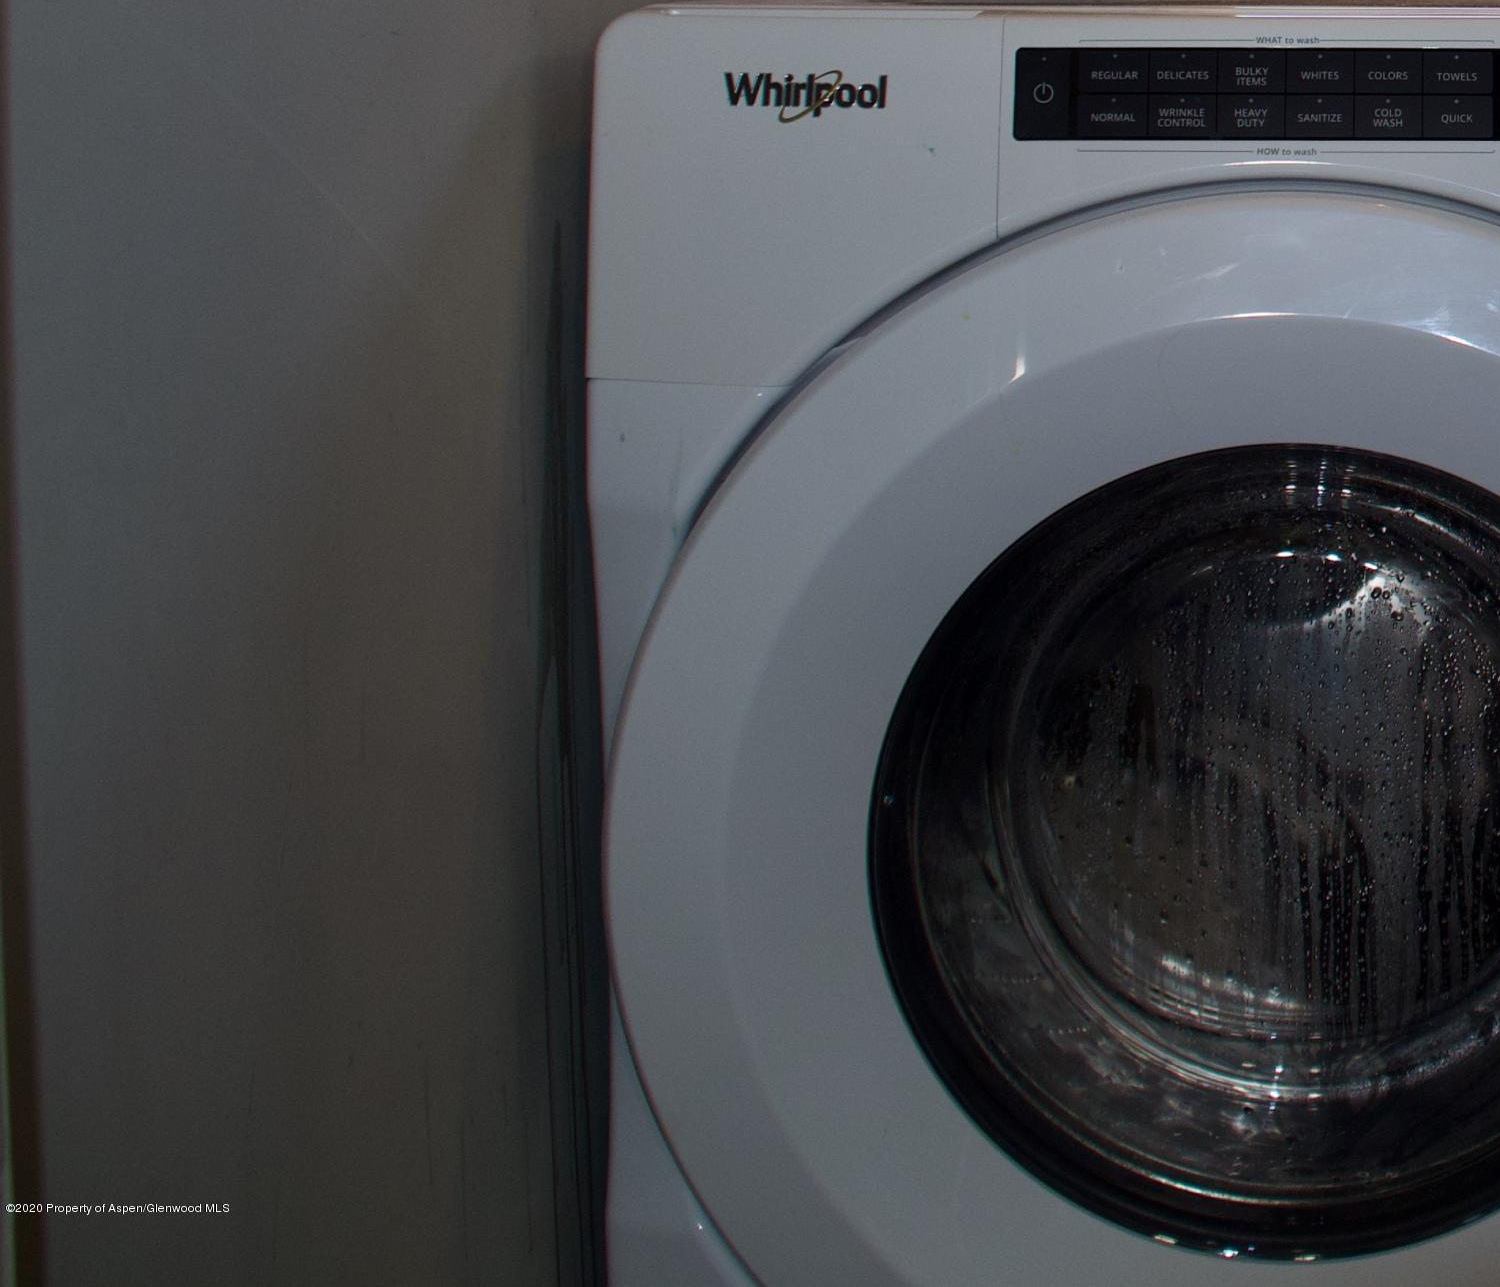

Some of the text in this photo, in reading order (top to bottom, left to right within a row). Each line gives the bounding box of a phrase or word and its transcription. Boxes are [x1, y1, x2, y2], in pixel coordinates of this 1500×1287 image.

[1256, 36, 1281, 44] WHAT
[1297, 36, 1320, 44] wash
[1091, 71, 1138, 80] REGULAR
[1157, 71, 1209, 80] DELICATES
[1235, 67, 1269, 76] BULKY
[1301, 71, 1340, 81] WHITES
[1368, 71, 1409, 81] COLORS
[1236, 77, 1267, 86] ITEMS
[1437, 72, 1478, 82] TOWELS
[724, 71, 888, 121] Whirlpool
[1090, 112, 1136, 122] NORMAL
[1158, 108, 1205, 117] WRINKLE
[1234, 108, 1268, 117] HEAVY
[1374, 108, 1402, 118] COLD
[1157, 118, 1206, 128] CONTROL
[1237, 118, 1265, 127] DUTY
[1297, 113, 1343, 123] SANITIZE
[1373, 118, 1403, 128] WASH
[1441, 113, 1473, 124] QUICK
